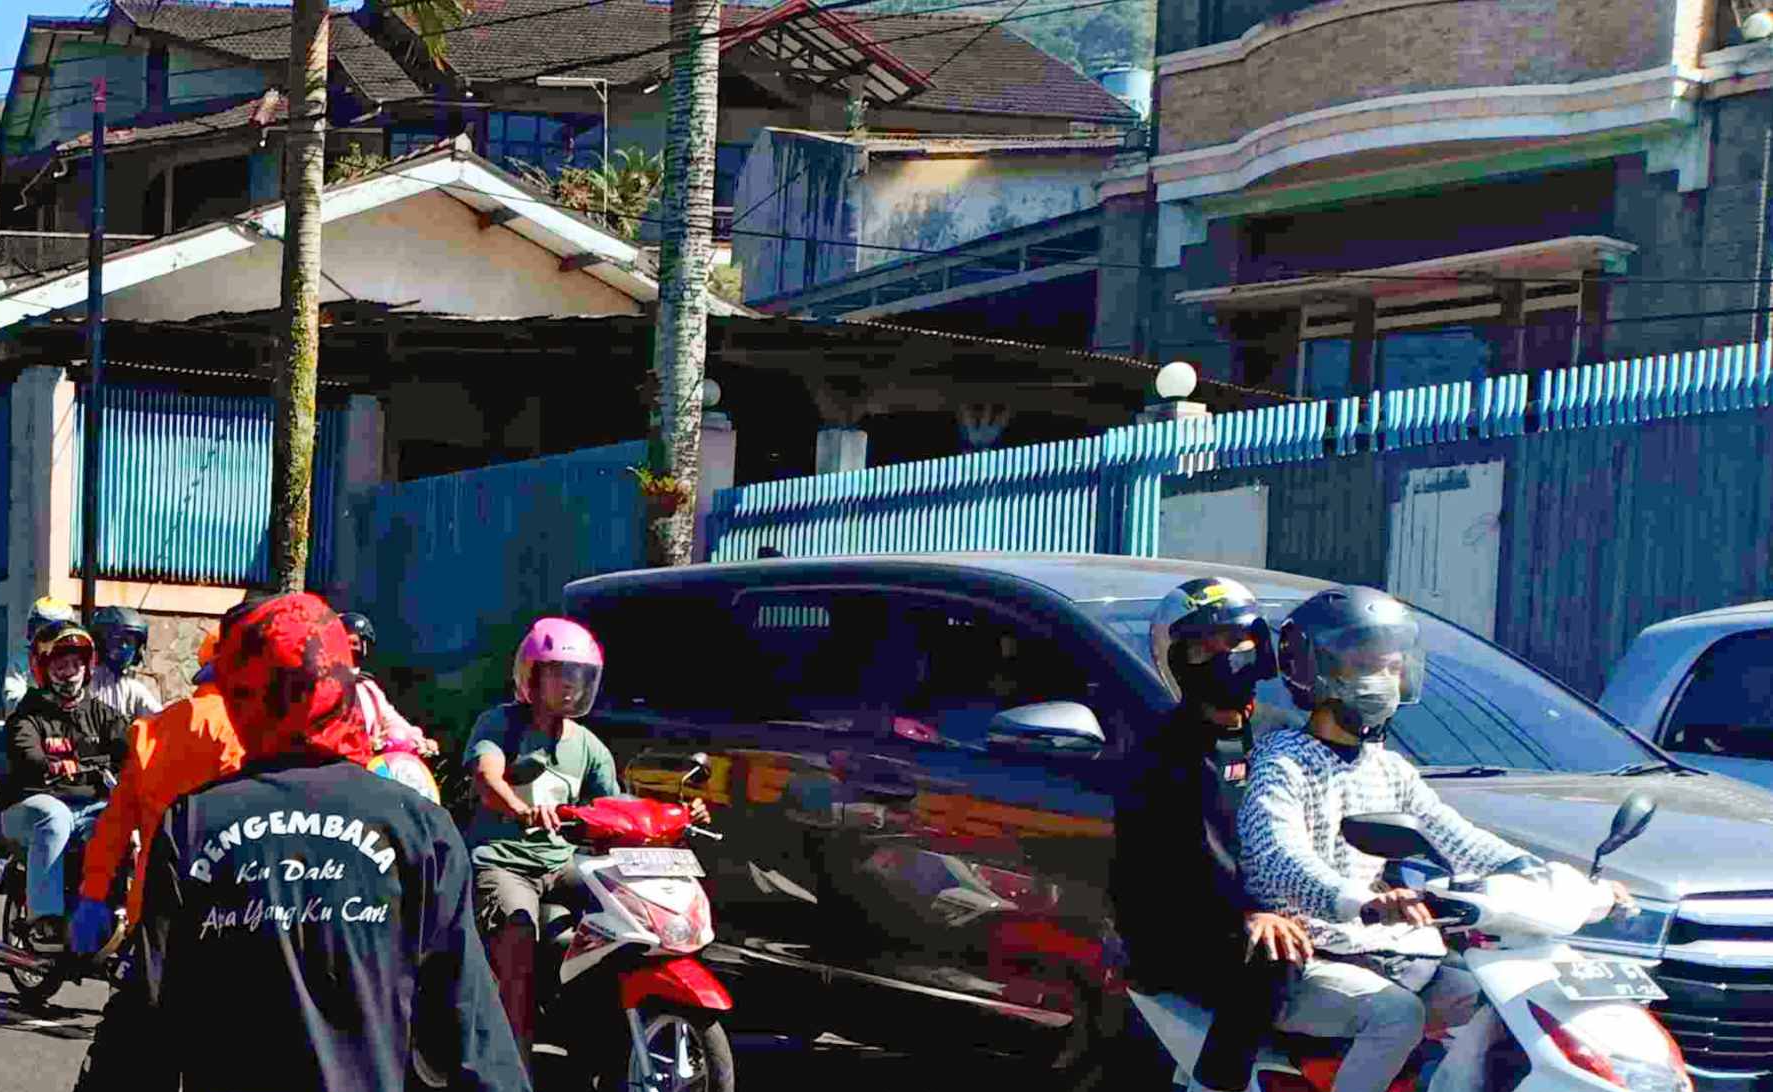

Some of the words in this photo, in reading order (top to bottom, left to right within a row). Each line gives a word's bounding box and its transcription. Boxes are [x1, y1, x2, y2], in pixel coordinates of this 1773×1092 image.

[189, 810, 397, 884] PENGEMBALA
[236, 860, 271, 885] Ku
[280, 858, 346, 882] Daki
[199, 906, 237, 940] Apa
[242, 898, 297, 932] Yang
[301, 897, 333, 923] Ku
[341, 896, 388, 923] Cari
